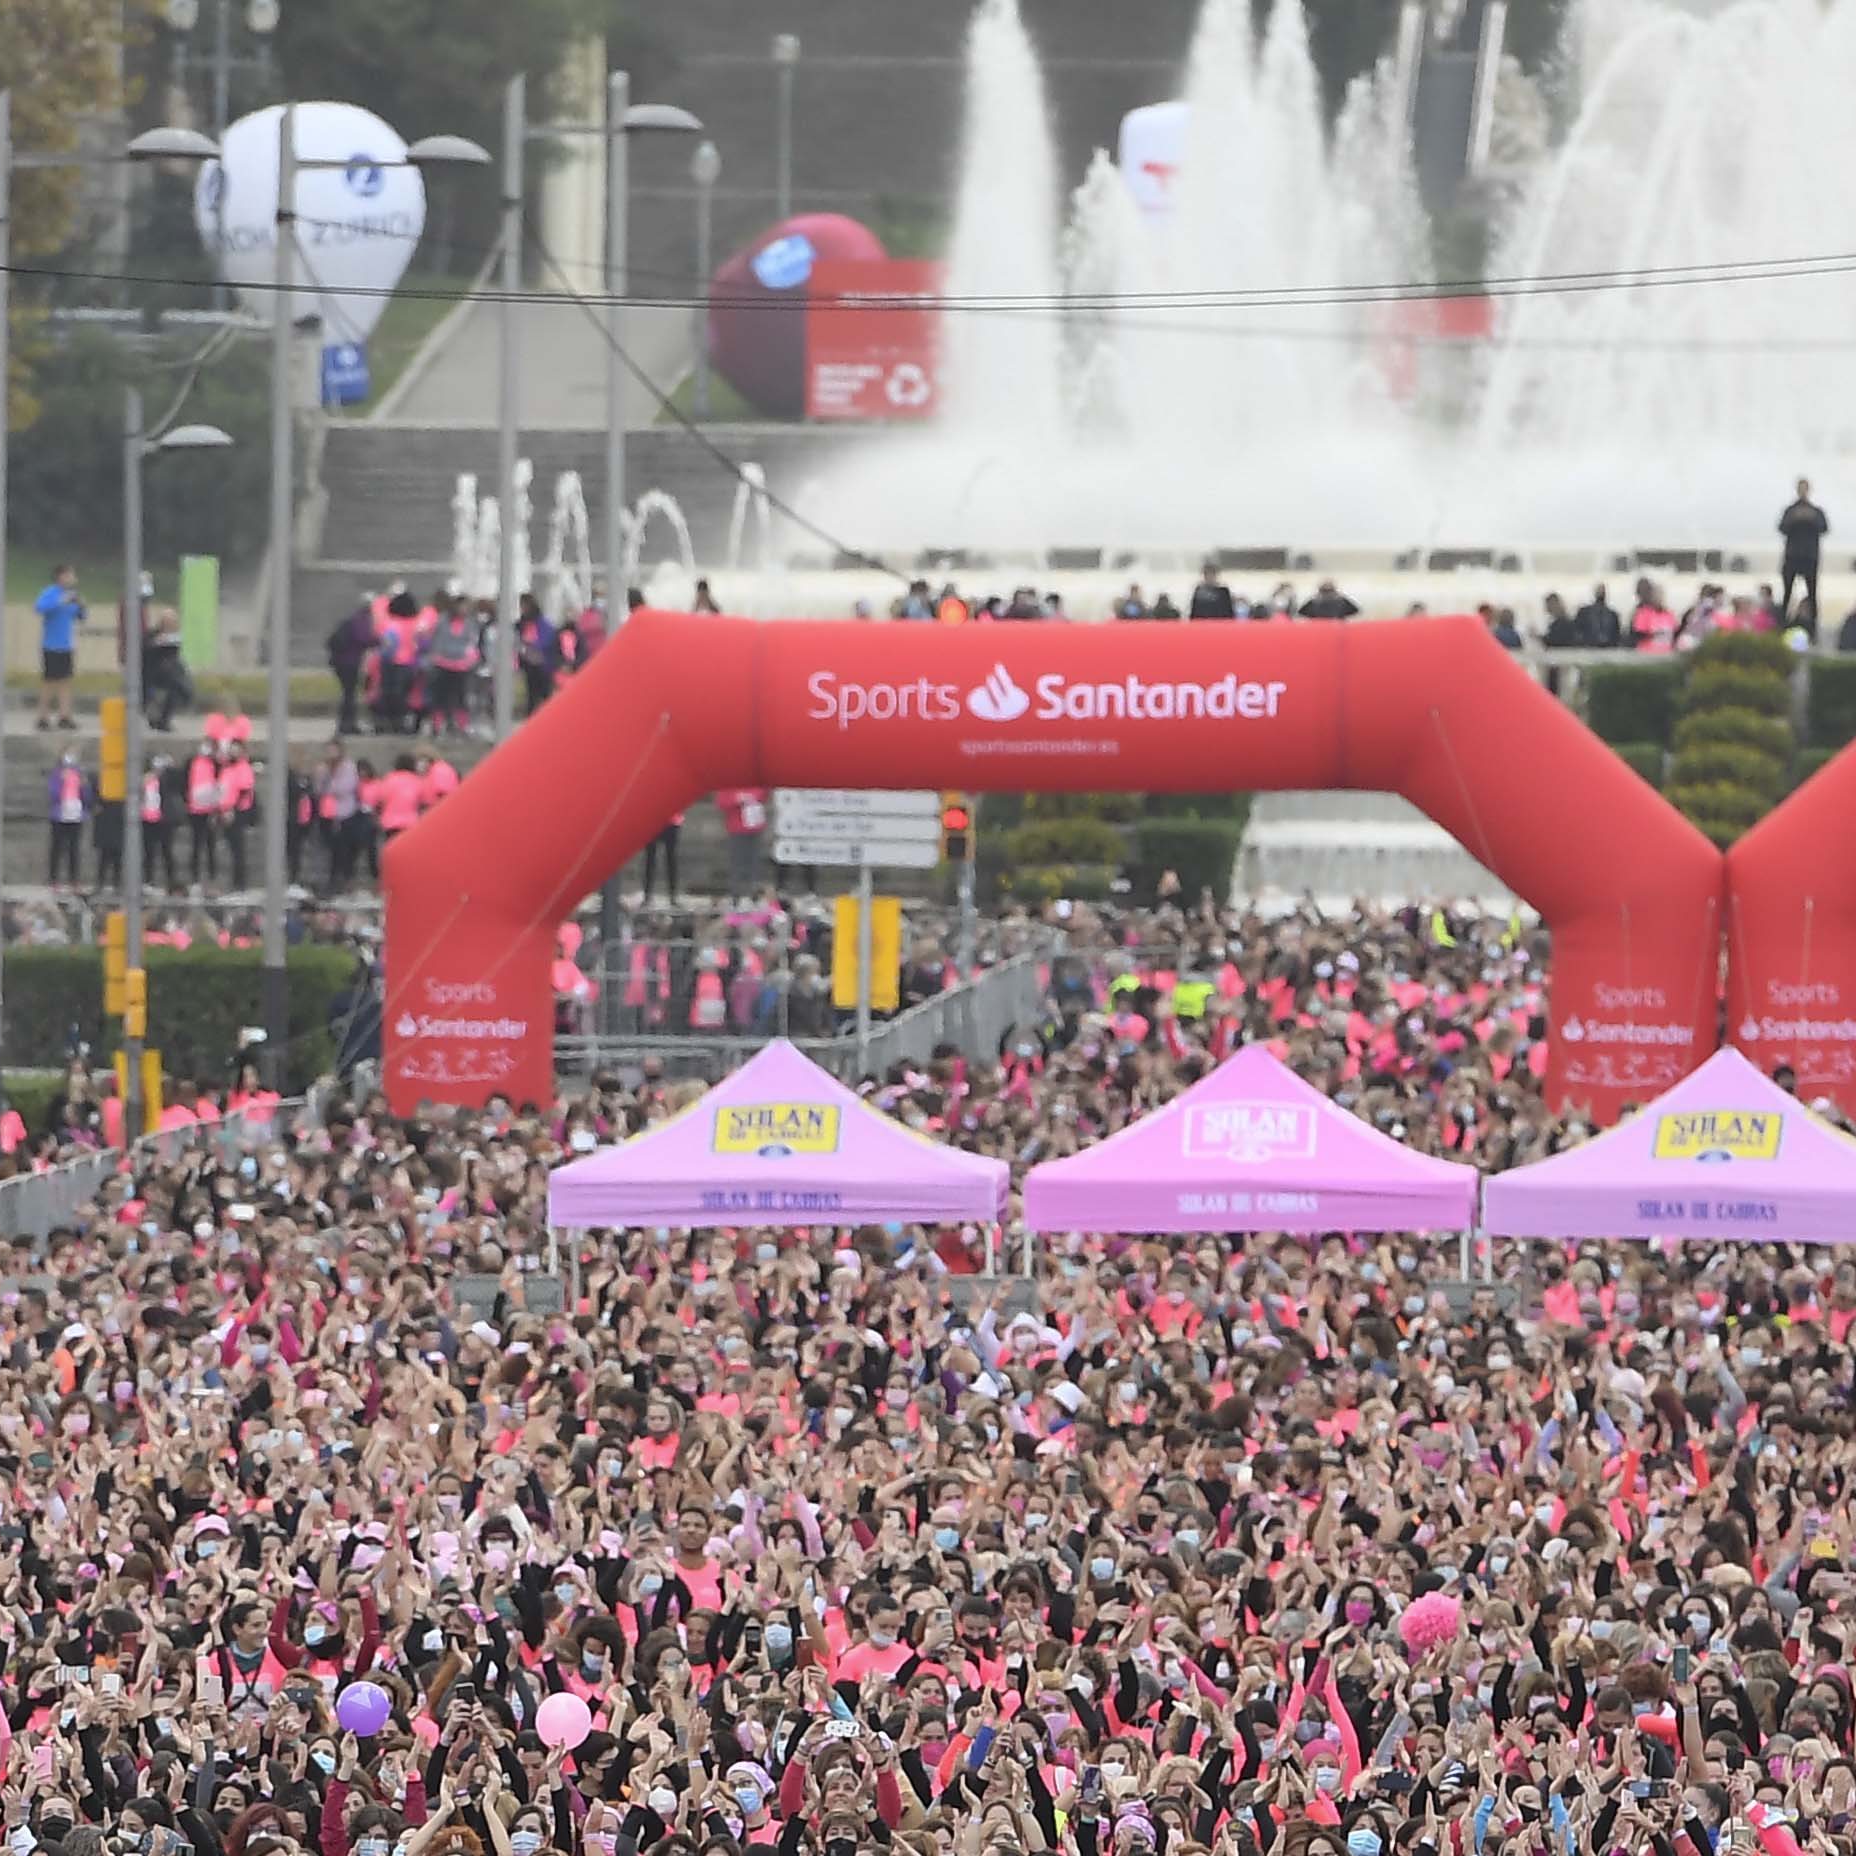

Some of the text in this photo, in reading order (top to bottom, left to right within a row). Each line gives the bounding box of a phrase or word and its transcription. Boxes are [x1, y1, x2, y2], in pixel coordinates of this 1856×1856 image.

[807, 670, 1288, 729] Sports Santander
[1592, 981, 1666, 1010] Sports
[1767, 979, 1840, 1006] Sports
[417, 1014, 528, 1039] Santander
[1584, 1019, 1694, 1045] Santander
